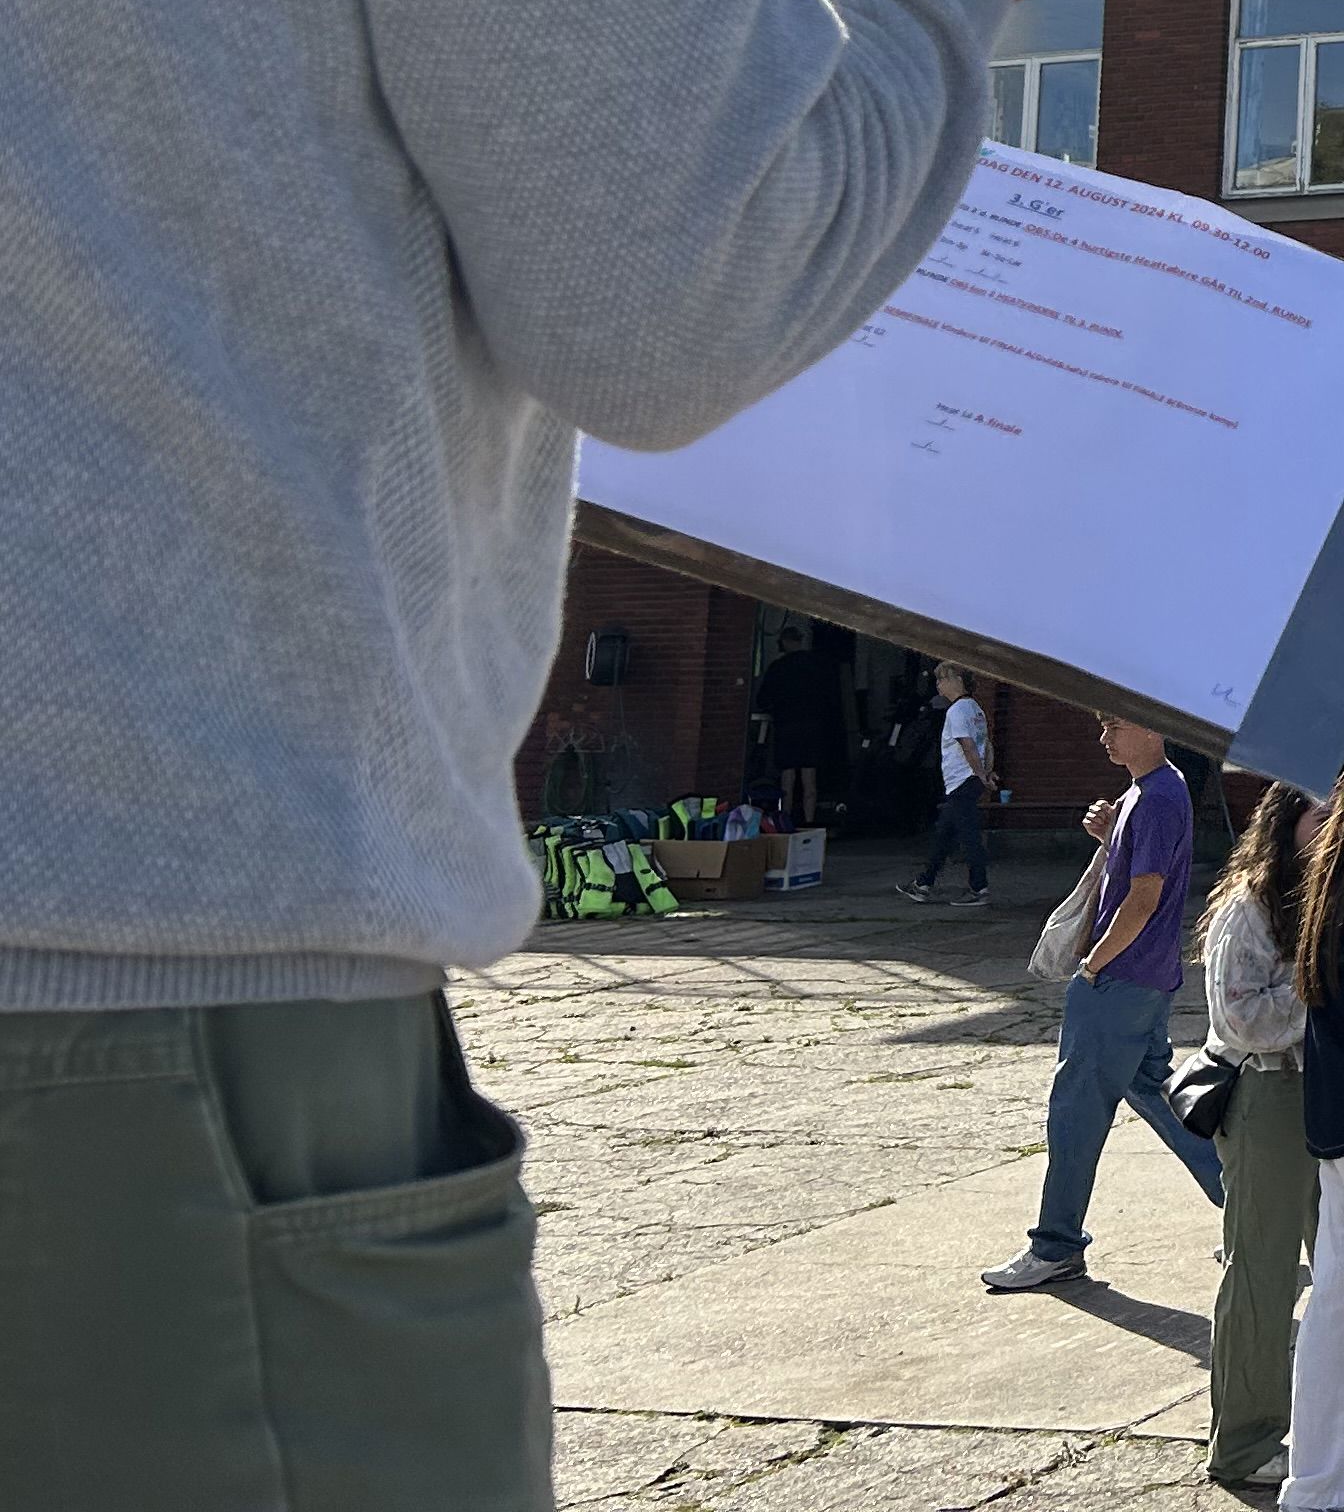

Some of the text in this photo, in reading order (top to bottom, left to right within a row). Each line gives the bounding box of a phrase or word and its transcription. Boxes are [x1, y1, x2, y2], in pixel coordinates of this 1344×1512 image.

[1010, 167, 1043, 183] DEN
[1067, 185, 1129, 209] AUGUST
[1130, 203, 1165, 219] 2024
